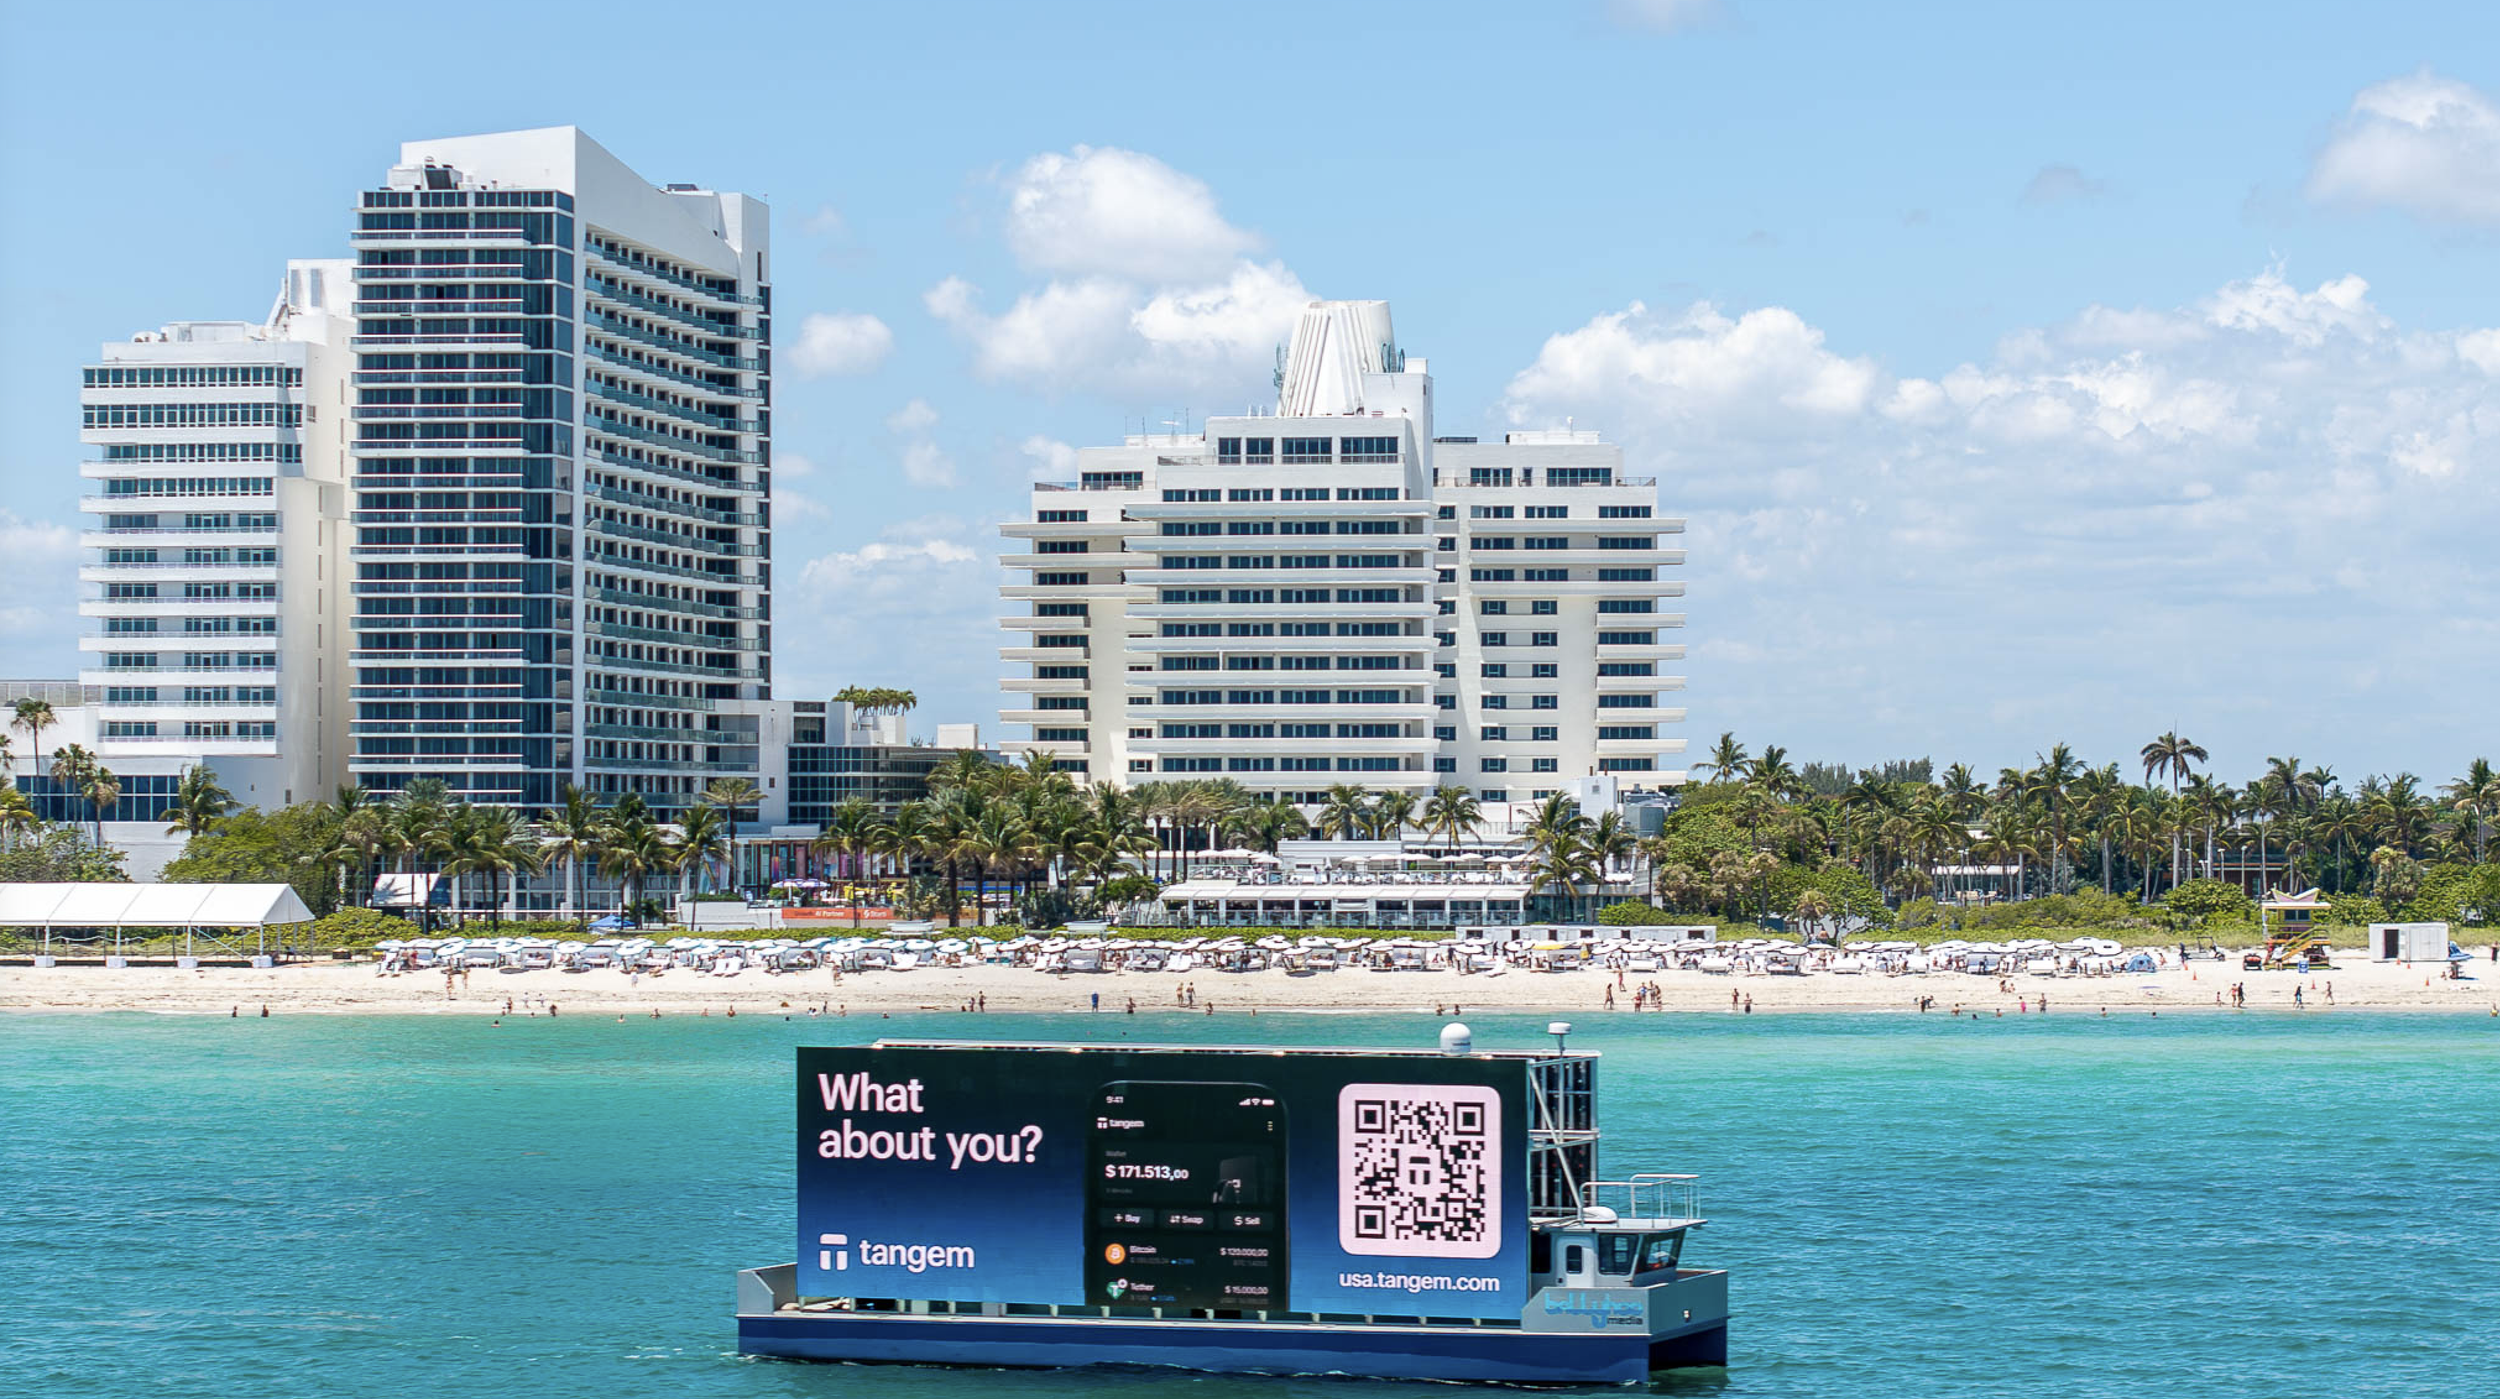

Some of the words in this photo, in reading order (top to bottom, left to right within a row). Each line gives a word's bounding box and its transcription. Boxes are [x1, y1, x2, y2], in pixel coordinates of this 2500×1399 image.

[818, 1071, 924, 1113] What
[1109, 1119, 1145, 1129] tangem
[818, 1118, 936, 1161] about
[946, 1124, 1044, 1170] you?
[1118, 1165, 1190, 1181] 171.513,00
[1124, 1214, 1142, 1224] Buy
[1182, 1215, 1204, 1225] Swap
[1244, 1216, 1261, 1225] Sell
[1129, 1245, 1157, 1254] Bitcoin
[859, 1239, 975, 1273] tangem
[1130, 1282, 1155, 1292] Tether
[1339, 1271, 1500, 1293] usa.tangem.com
[1607, 1316, 1643, 1325] media
